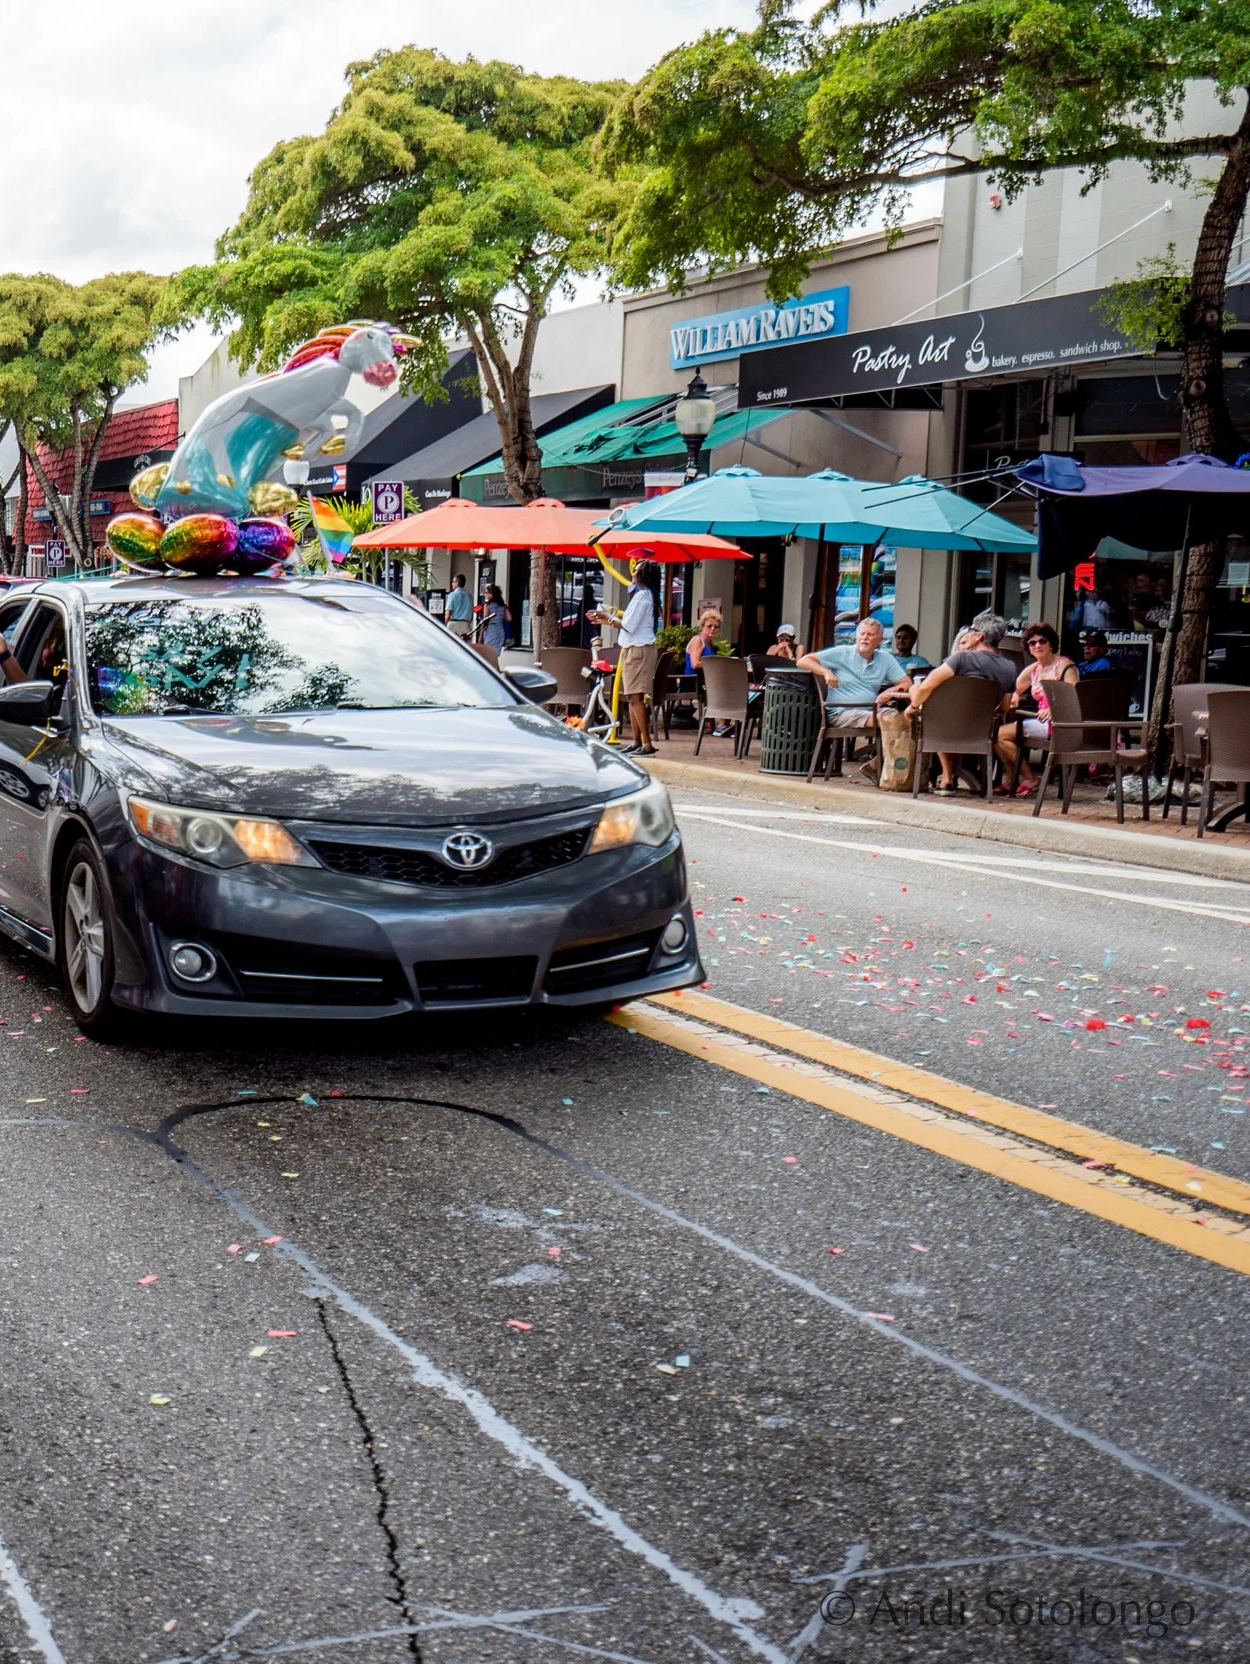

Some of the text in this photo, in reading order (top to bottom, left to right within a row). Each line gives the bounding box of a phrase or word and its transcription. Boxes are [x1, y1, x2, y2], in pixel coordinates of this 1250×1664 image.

[670, 300, 835, 361] WILLIAM RAVEIS
[852, 334, 956, 384] Pastry Art
[991, 338, 1123, 368] bakery. espresso. sandwich shop.
[756, 391, 772, 401] Since
[378, 484, 398, 492] PAY
[384, 495, 394, 510] P
[375, 513, 401, 521] HERE
[1078, 631, 1153, 643] Swiches
